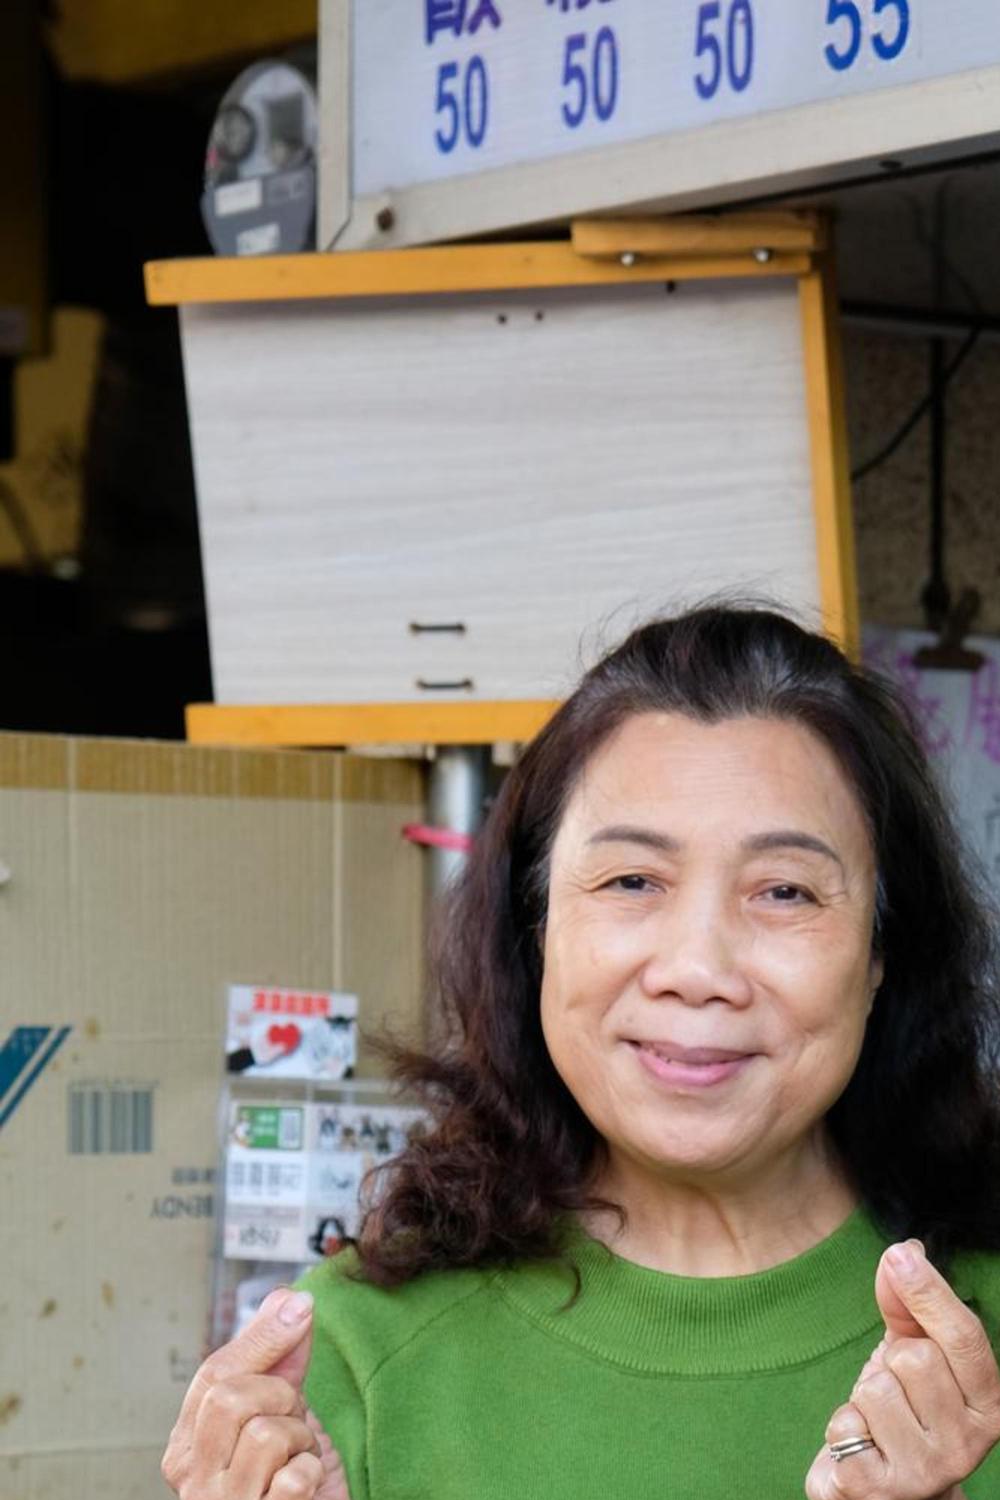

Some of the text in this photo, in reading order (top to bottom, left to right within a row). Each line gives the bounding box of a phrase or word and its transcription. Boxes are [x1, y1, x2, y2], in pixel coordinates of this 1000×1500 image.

[434, 0, 910, 154] 50 50 50 55
